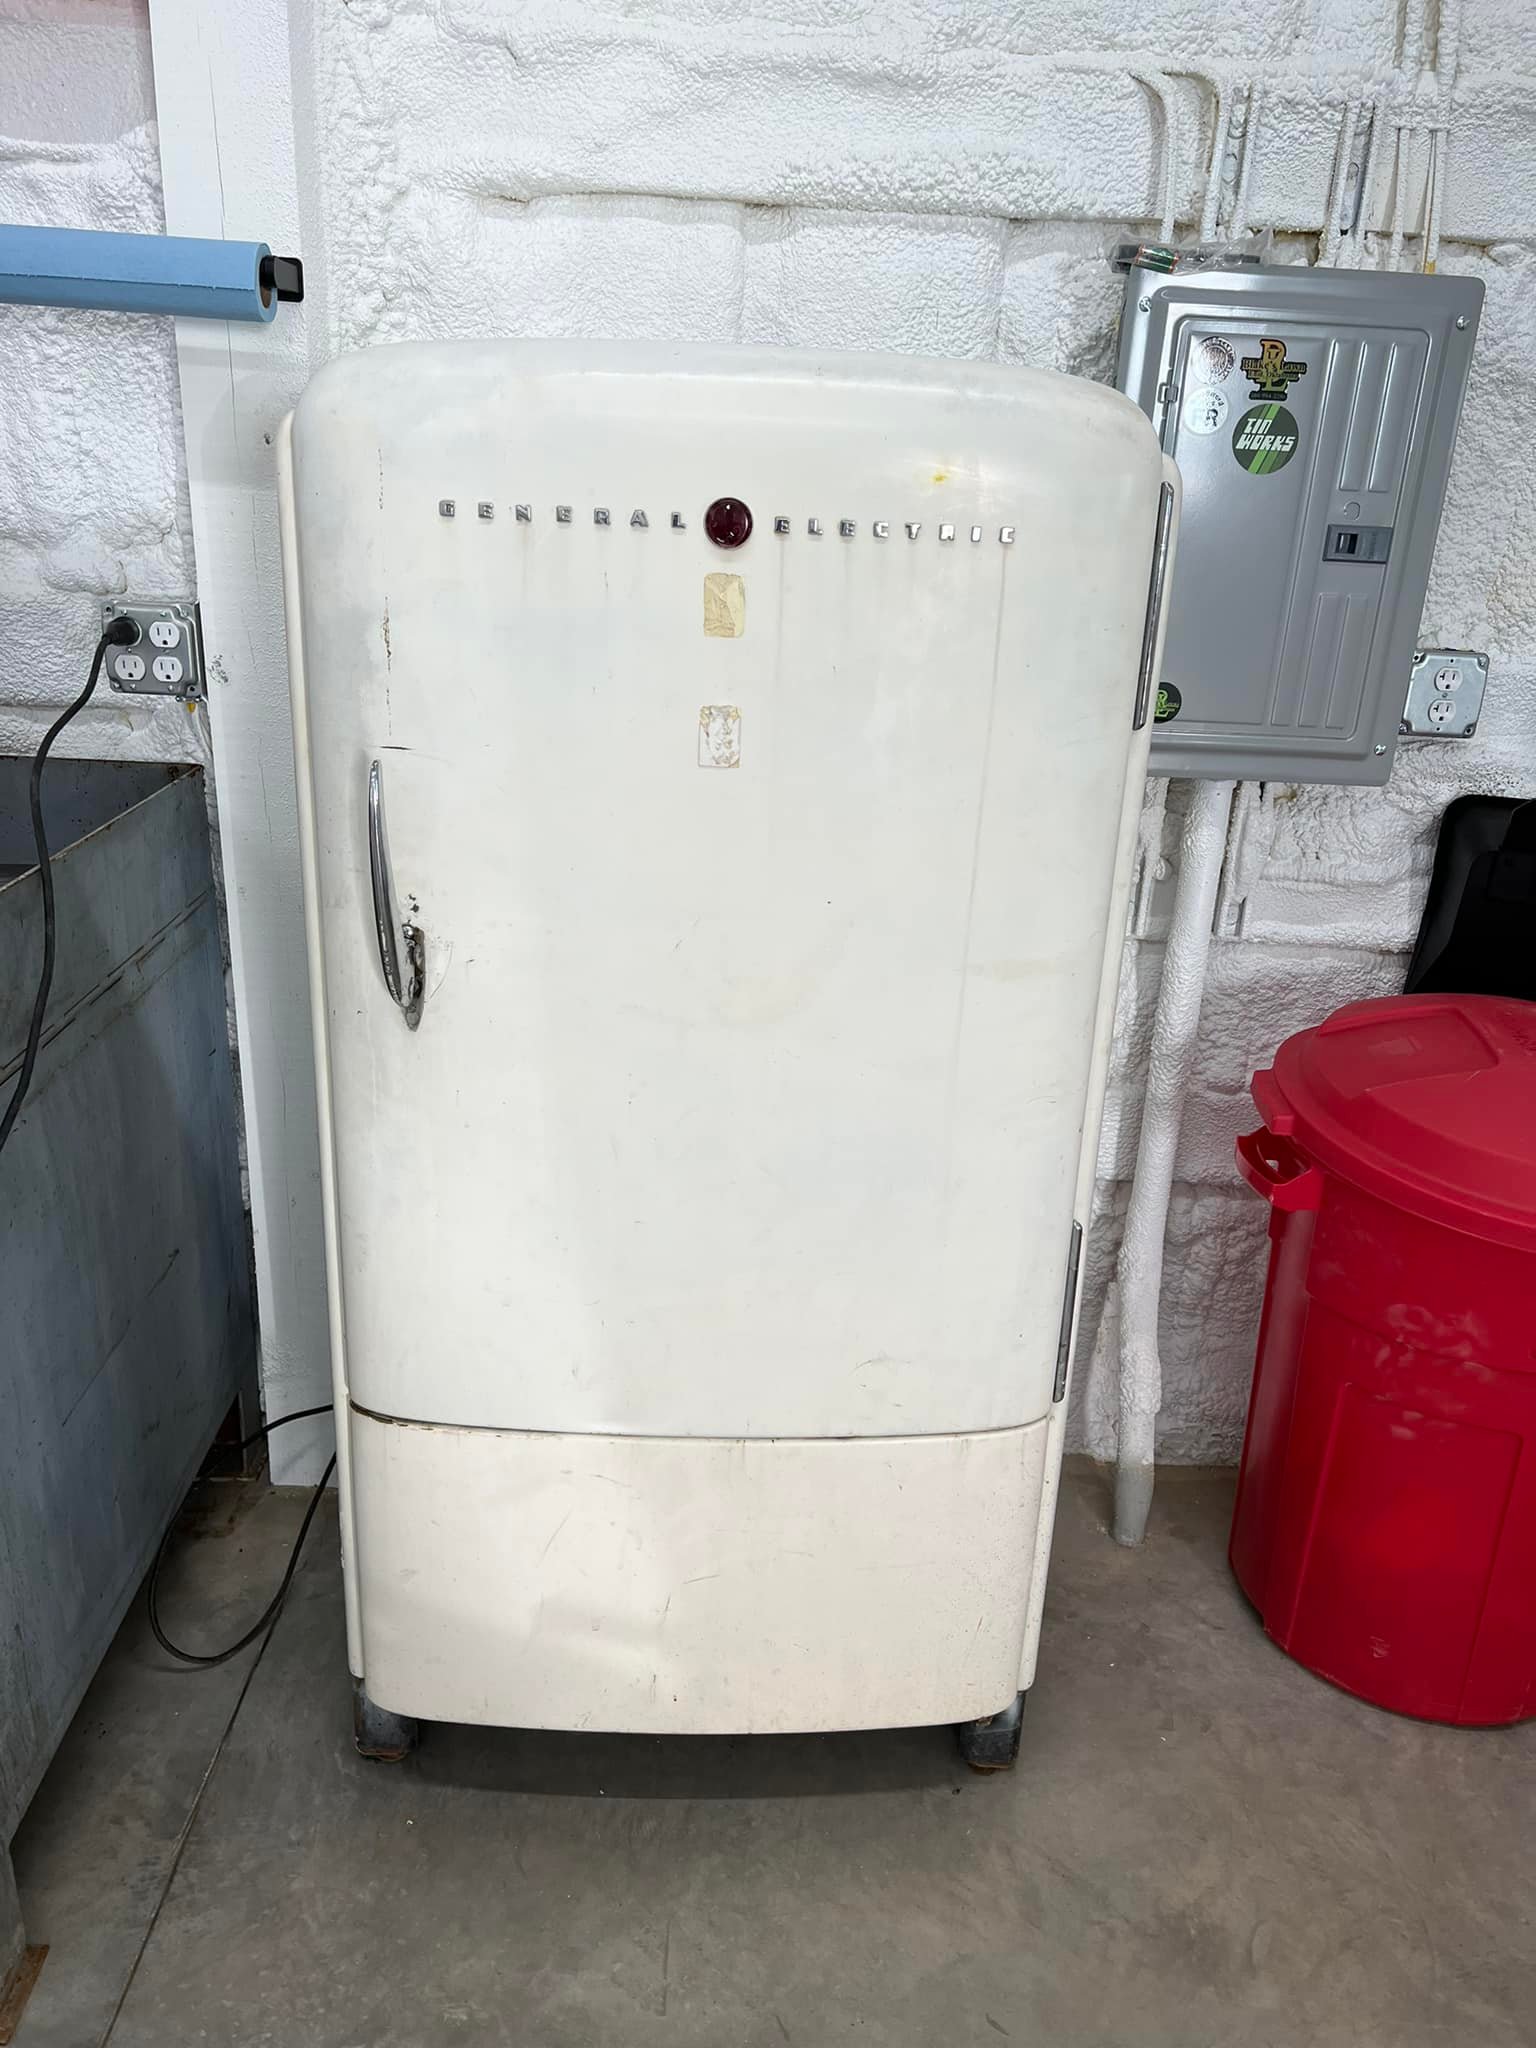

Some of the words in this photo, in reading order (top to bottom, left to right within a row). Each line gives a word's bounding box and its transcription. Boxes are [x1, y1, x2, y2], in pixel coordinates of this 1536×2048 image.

[1235, 434, 1296, 452] WORKS
[439, 500, 686, 529] GENERAL
[774, 516, 1015, 544] ELECTRIC
